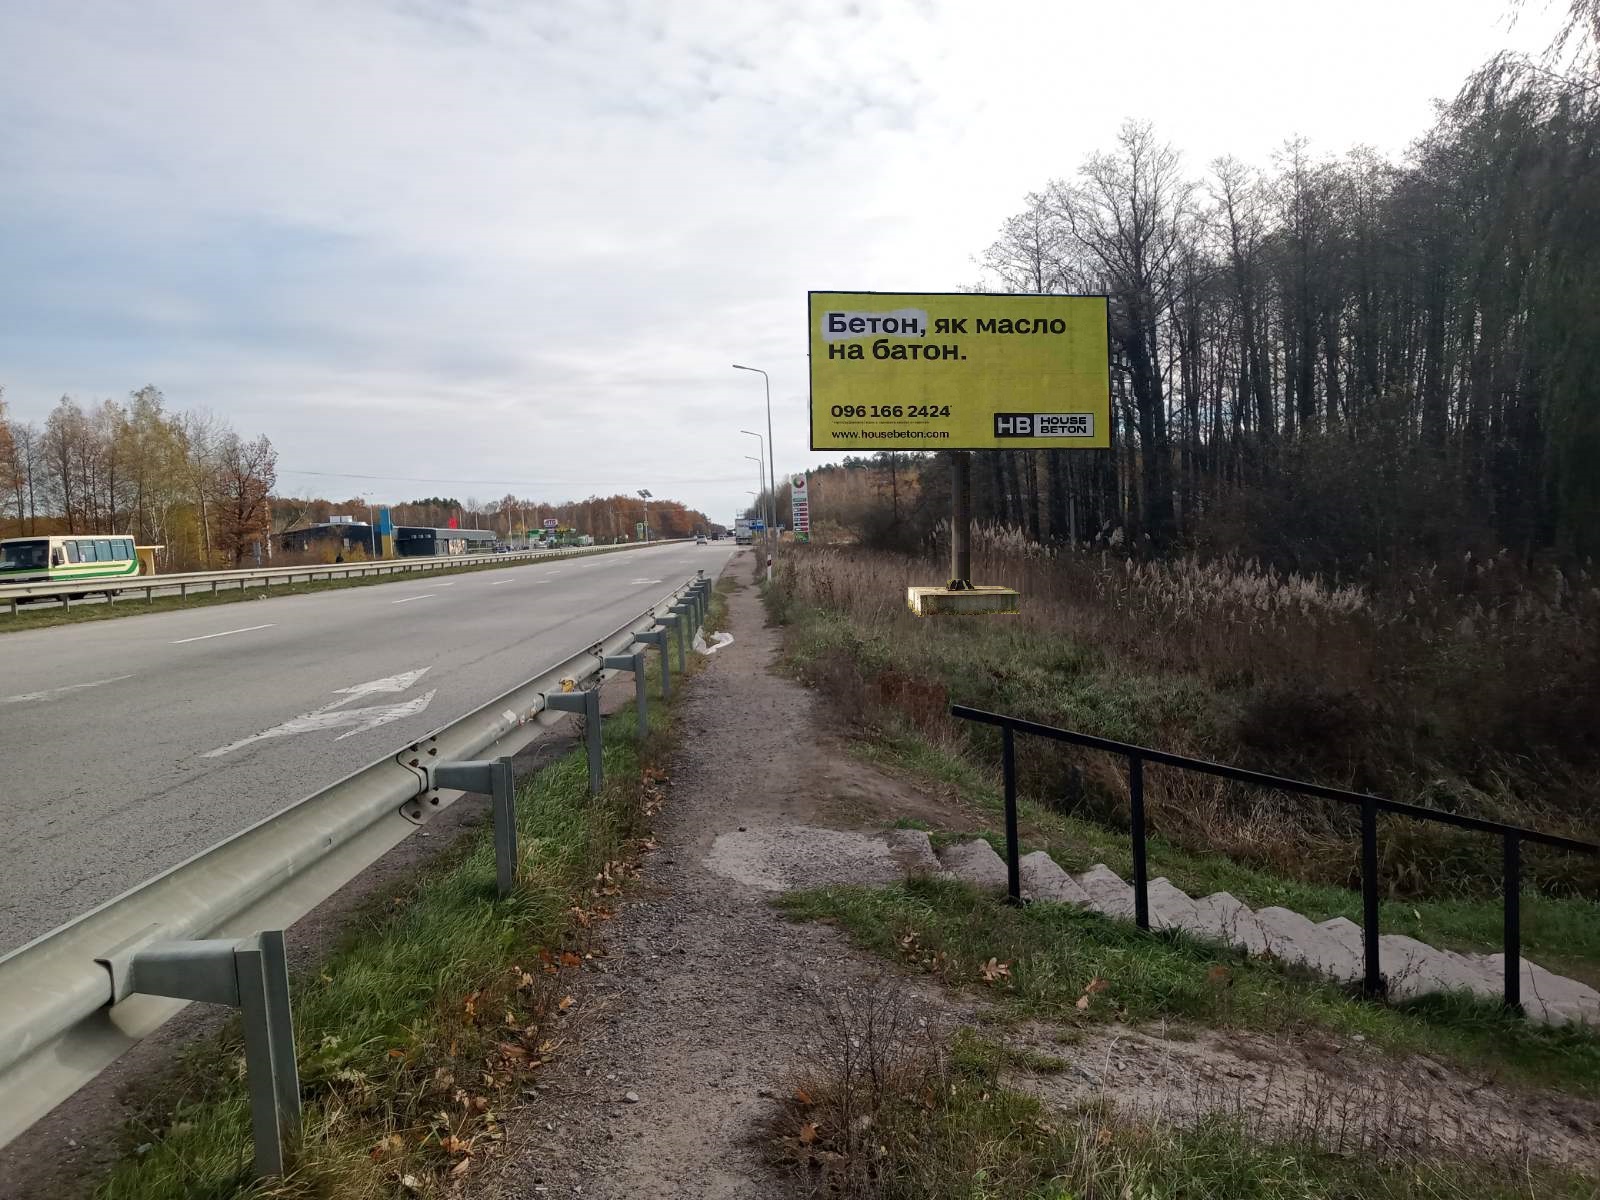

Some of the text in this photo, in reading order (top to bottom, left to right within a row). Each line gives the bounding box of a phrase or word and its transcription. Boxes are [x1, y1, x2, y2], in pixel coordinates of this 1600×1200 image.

[828, 313, 1066, 337] Бетон, як масло
[828, 339, 967, 360] на батон.
[831, 405, 866, 417] 096
[870, 405, 903, 417] 166
[997, 417, 1031, 434] HB
[1040, 416, 1087, 425] HOUSE
[831, 430, 950, 439] www.housebeton.com
[1040, 425, 1087, 434] BETON
